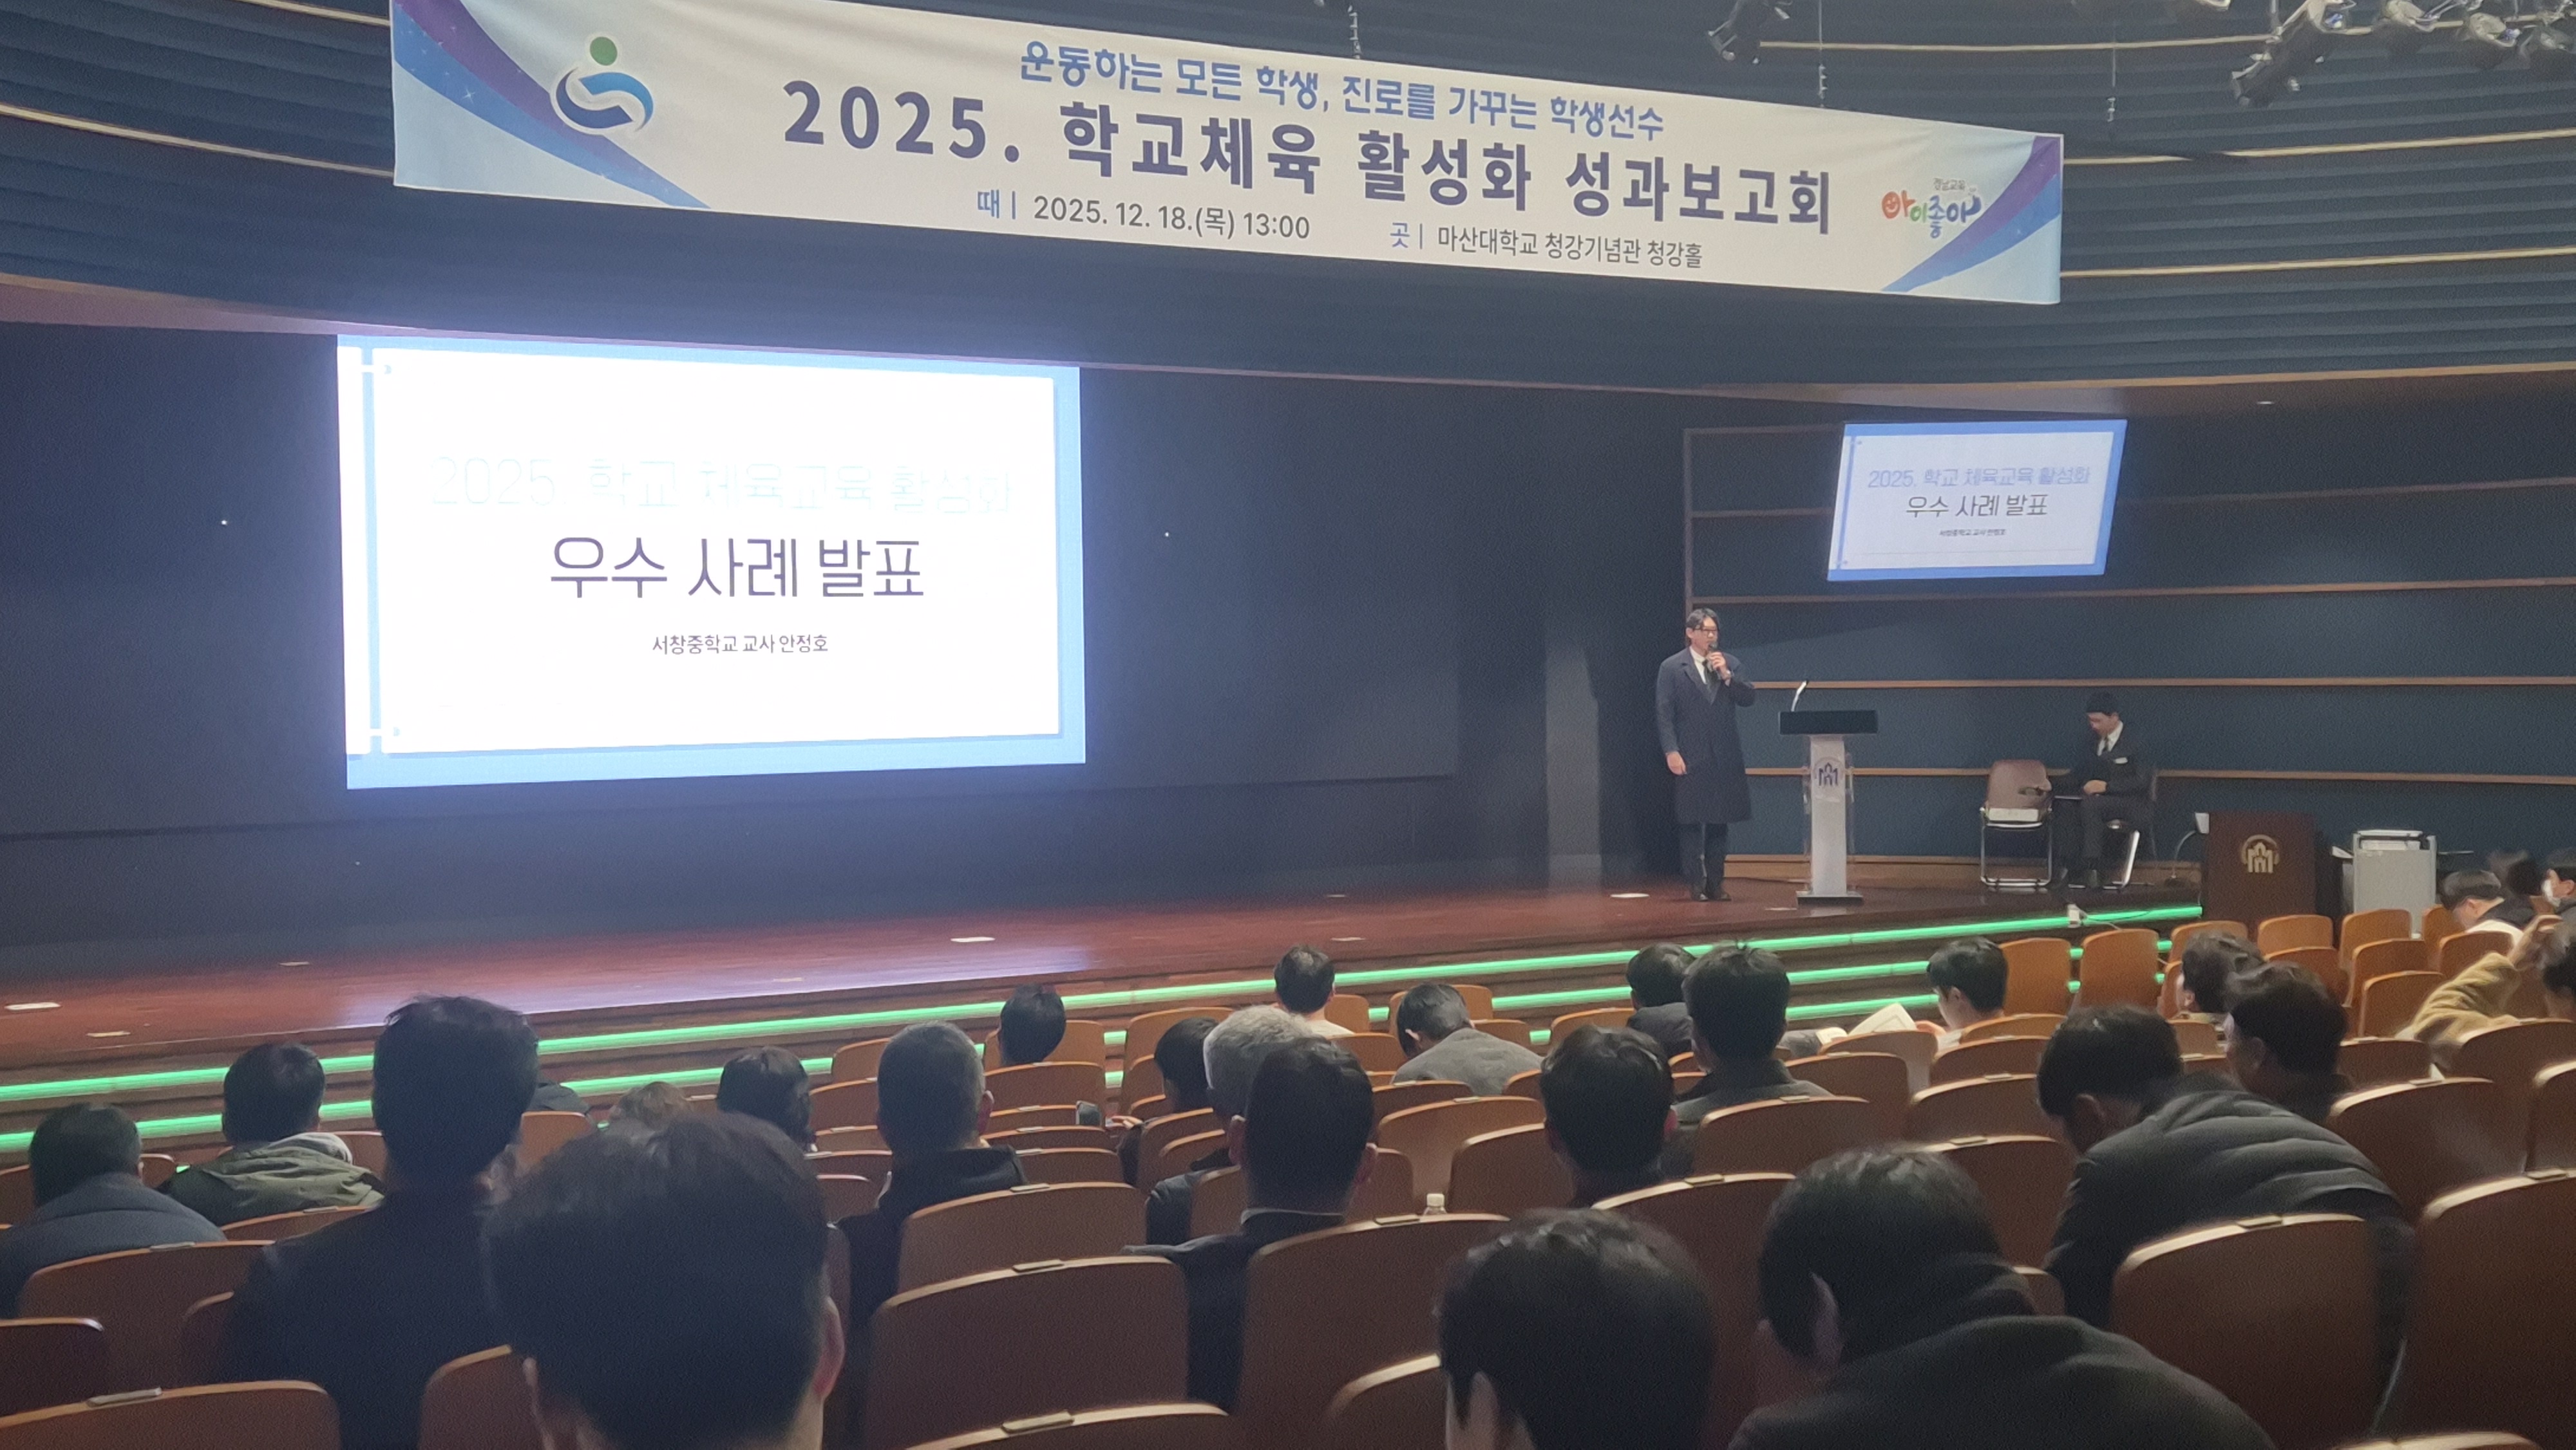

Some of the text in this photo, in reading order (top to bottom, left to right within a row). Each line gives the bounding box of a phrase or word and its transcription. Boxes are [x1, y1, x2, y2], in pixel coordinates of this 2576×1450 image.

[1021, 41, 1664, 141] 운동하는 모든 학생, 진로를 가꾸는 학생선수
[782, 80, 1830, 235] 2025. 학교체육 활성화 성과보고회
[1034, 196, 1108, 225] 2025.
[1115, 202, 1151, 227] 12.
[1159, 205, 1235, 239] 18.(목)
[1244, 212, 1310, 239] 13:00
[1882, 190, 1982, 238] 아이좋아
[1438, 225, 1539, 256] 마산대학교
[1545, 232, 1641, 264] 청강기념관
[1647, 240, 1703, 268] 청강홀
[431, 456, 1015, 514] 2025. 학교 체육교육 활성화
[1906, 493, 2049, 518] 우수 사례 발표
[551, 537, 923, 599] 우수 사례 발표
[652, 634, 828, 655] 서창중학교 교사 안정호
